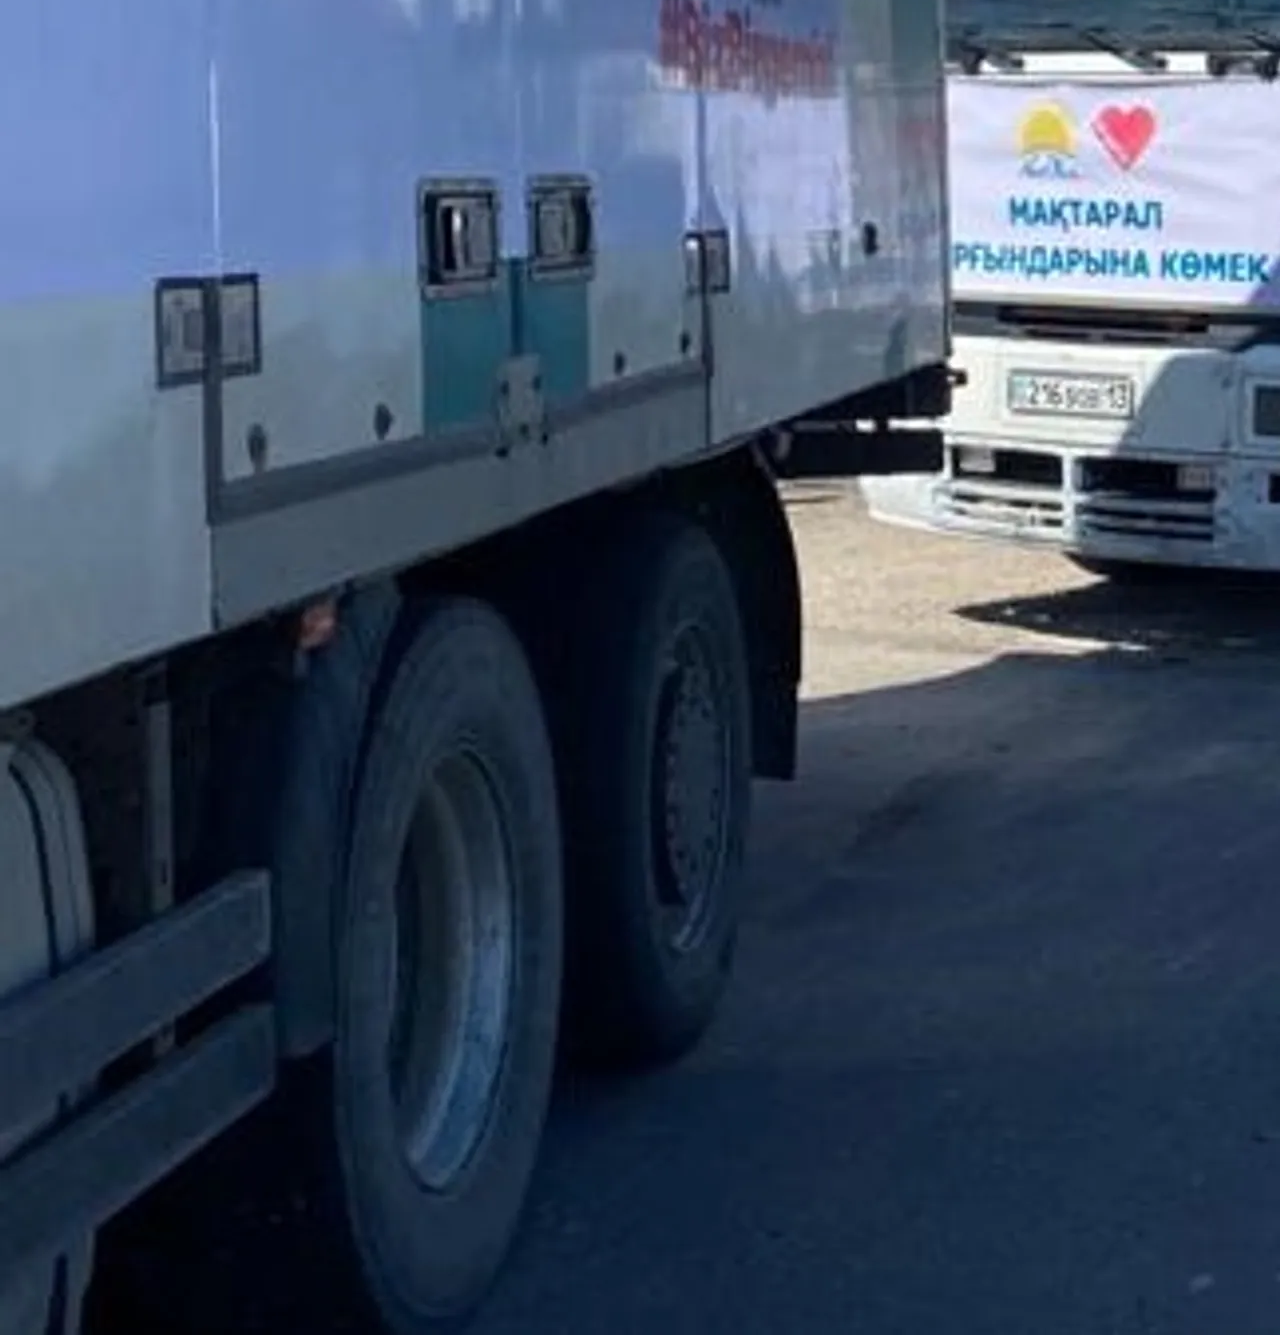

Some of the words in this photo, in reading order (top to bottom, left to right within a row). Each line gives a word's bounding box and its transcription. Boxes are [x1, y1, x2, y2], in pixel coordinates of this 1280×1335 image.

[1009, 196, 1163, 233] МАҚТАРАЛ
[953, 241, 1150, 281] РҒЫНДАРЫНА
[1160, 249, 1271, 283] КӨМЕК
